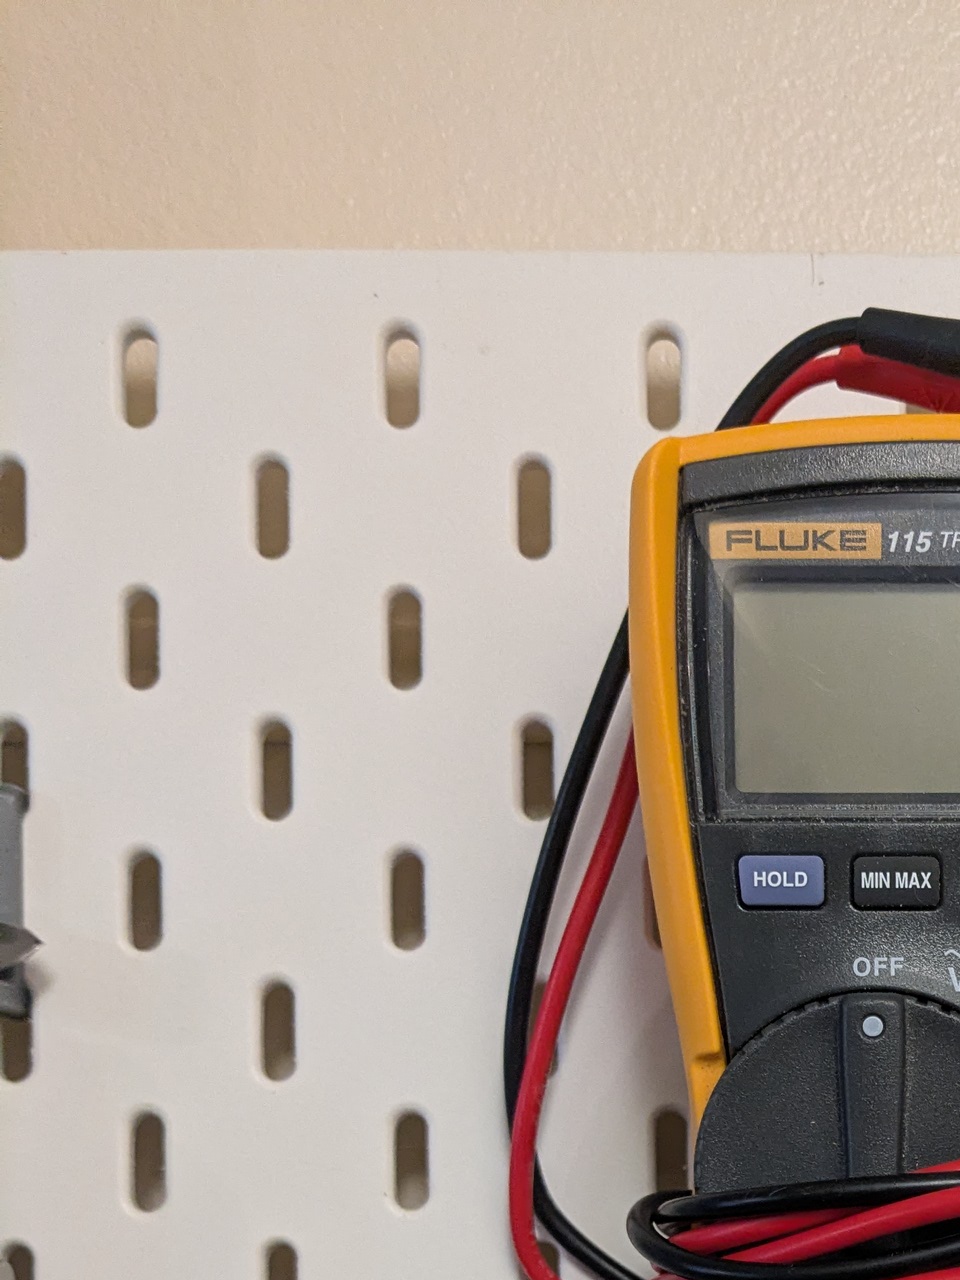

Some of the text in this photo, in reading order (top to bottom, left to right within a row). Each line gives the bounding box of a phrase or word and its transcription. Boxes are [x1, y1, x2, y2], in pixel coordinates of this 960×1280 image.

[724, 528, 869, 553] FLUKE
[886, 532, 933, 553] 115
[752, 871, 809, 888] HOLD
[860, 872, 932, 890] MIN MAX
[852, 956, 904, 978] OFF
